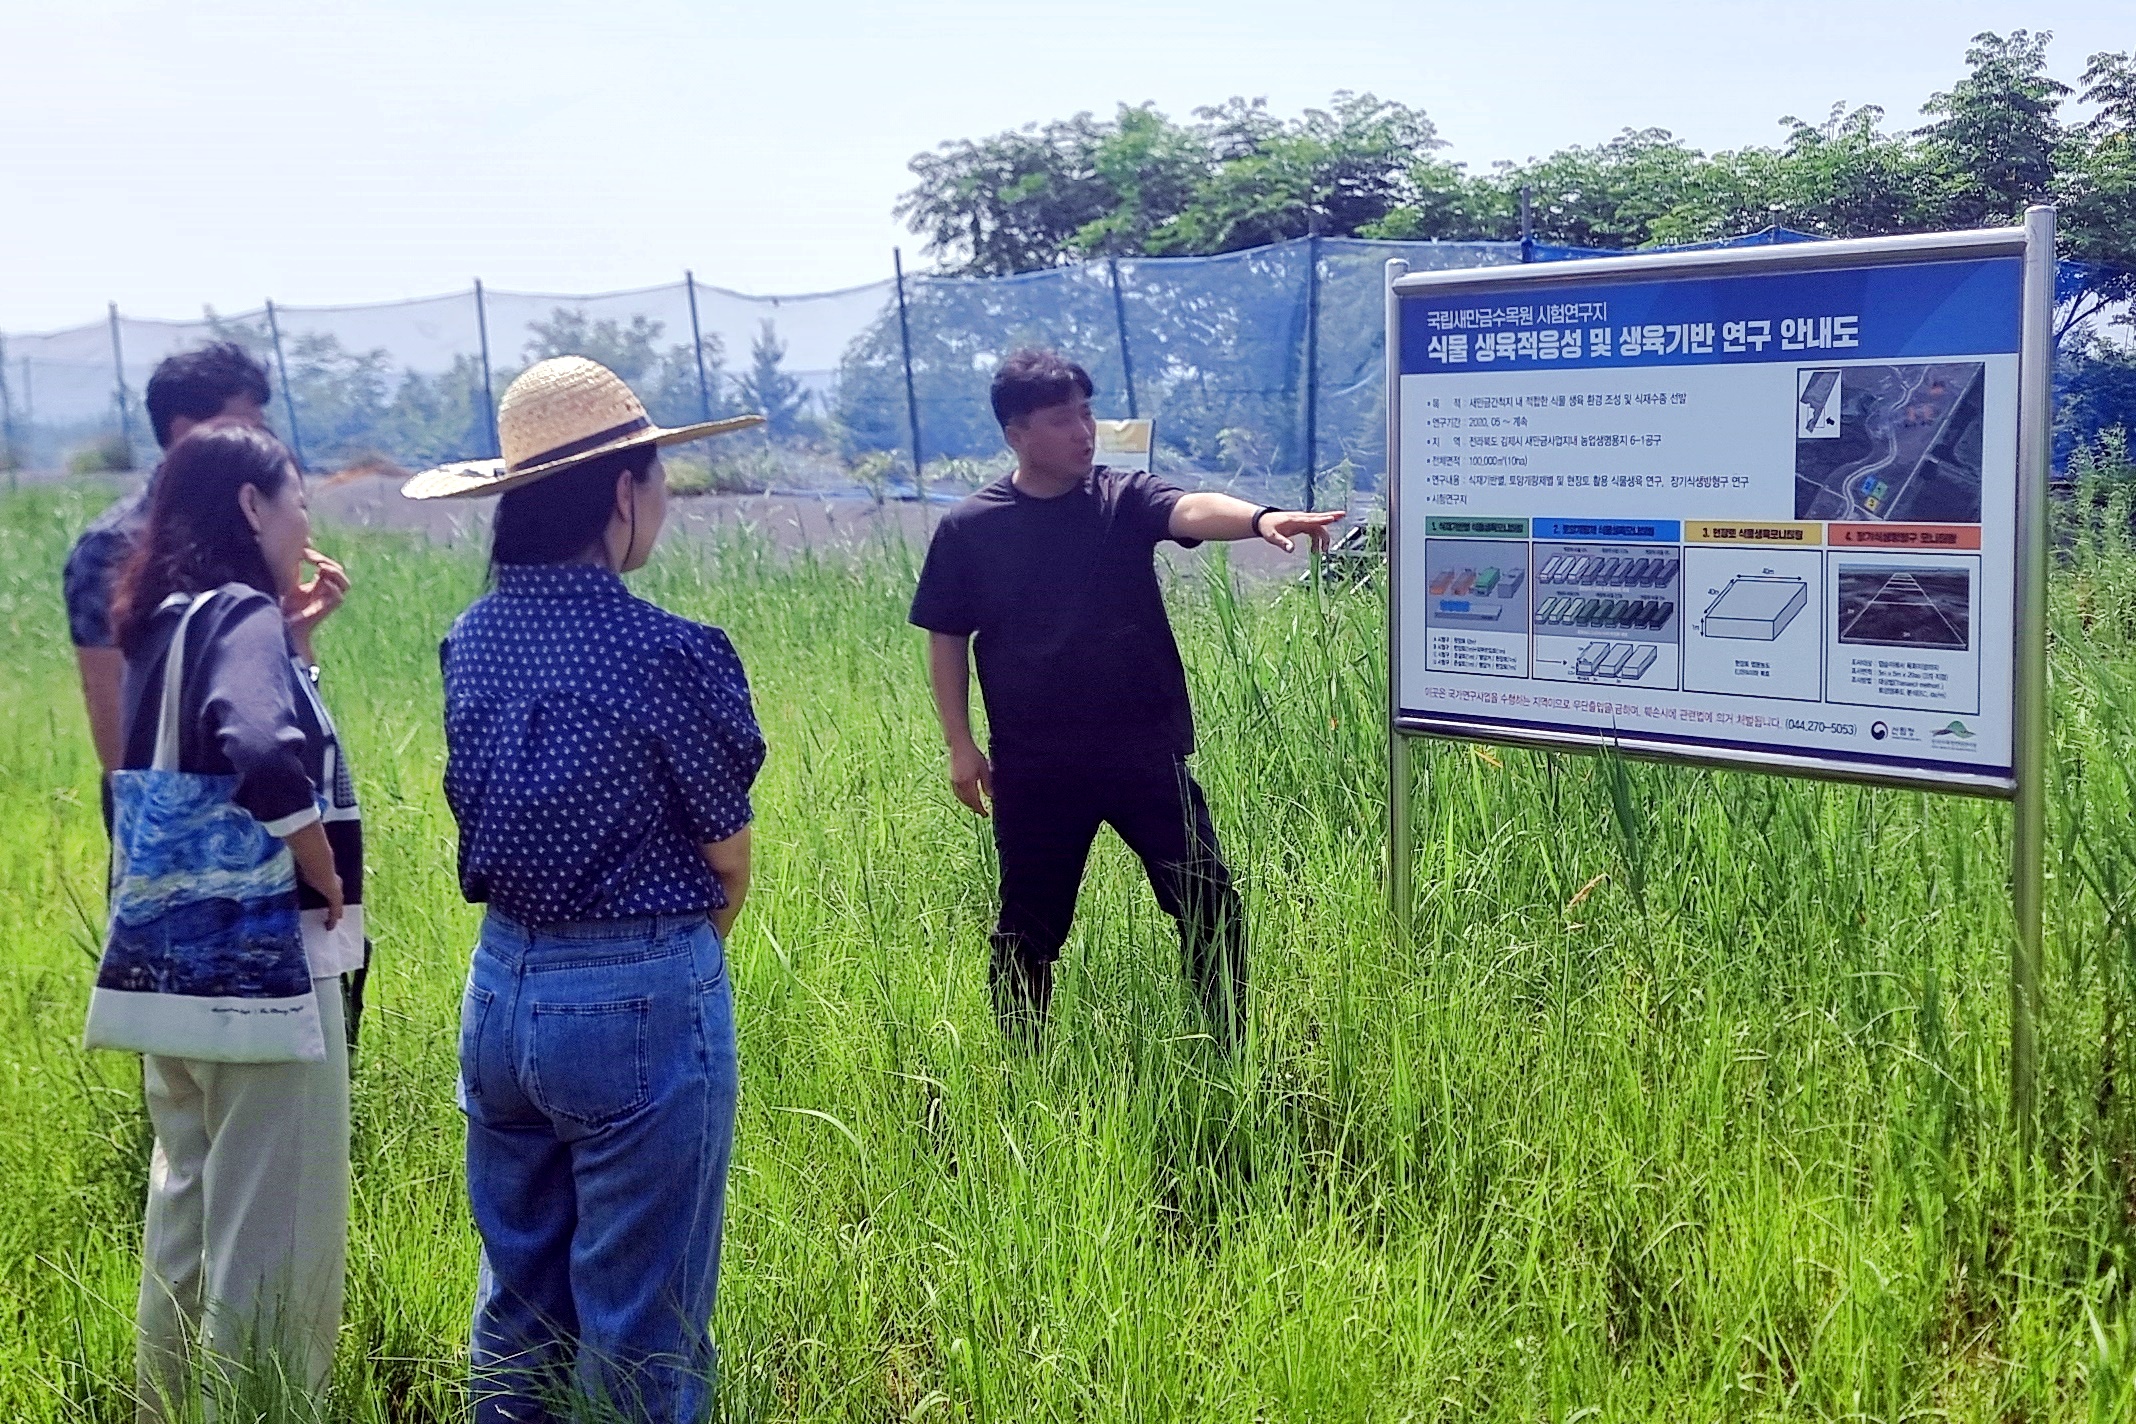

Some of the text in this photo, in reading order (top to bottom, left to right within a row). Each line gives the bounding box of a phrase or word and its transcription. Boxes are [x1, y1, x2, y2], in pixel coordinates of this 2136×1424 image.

[1427, 302, 1608, 331] 국립새만금수목원 시험연구지
[1427, 316, 1859, 364] 식물 생육적응성 및 생육기반 연구 안내도
[1515, 396, 1523, 408] 내
[1551, 395, 1566, 407] 식물
[1569, 394, 1584, 407] 생육
[1587, 394, 1603, 407] 환경
[1605, 393, 1622, 406] 조성
[1624, 393, 1632, 406] 및
[1635, 393, 1668, 405] 식재수종
[1670, 392, 1687, 405] 선발
[1432, 417, 1461, 428] 연구기간
[1513, 416, 1528, 427] 계속
[1432, 437, 1440, 447] 지
[1453, 436, 1461, 447] 역
[1469, 436, 1499, 447] 전라북도
[1501, 435, 1523, 447] 김제시
[1580, 435, 1628, 447] 농업생명용지
[1431, 475, 1460, 486] 연구내용
[1556, 475, 1564, 486] 및
[1593, 475, 1608, 487] 활용
[1611, 475, 1643, 487] 식물생육
[1732, 476, 1750, 488] 연구
[1432, 493, 1468, 505] 시험연구지
[1424, 687, 1446, 699] 이곳은
[1680, 709, 1713, 723] 관련법에
[1716, 712, 1734, 725] 의거
